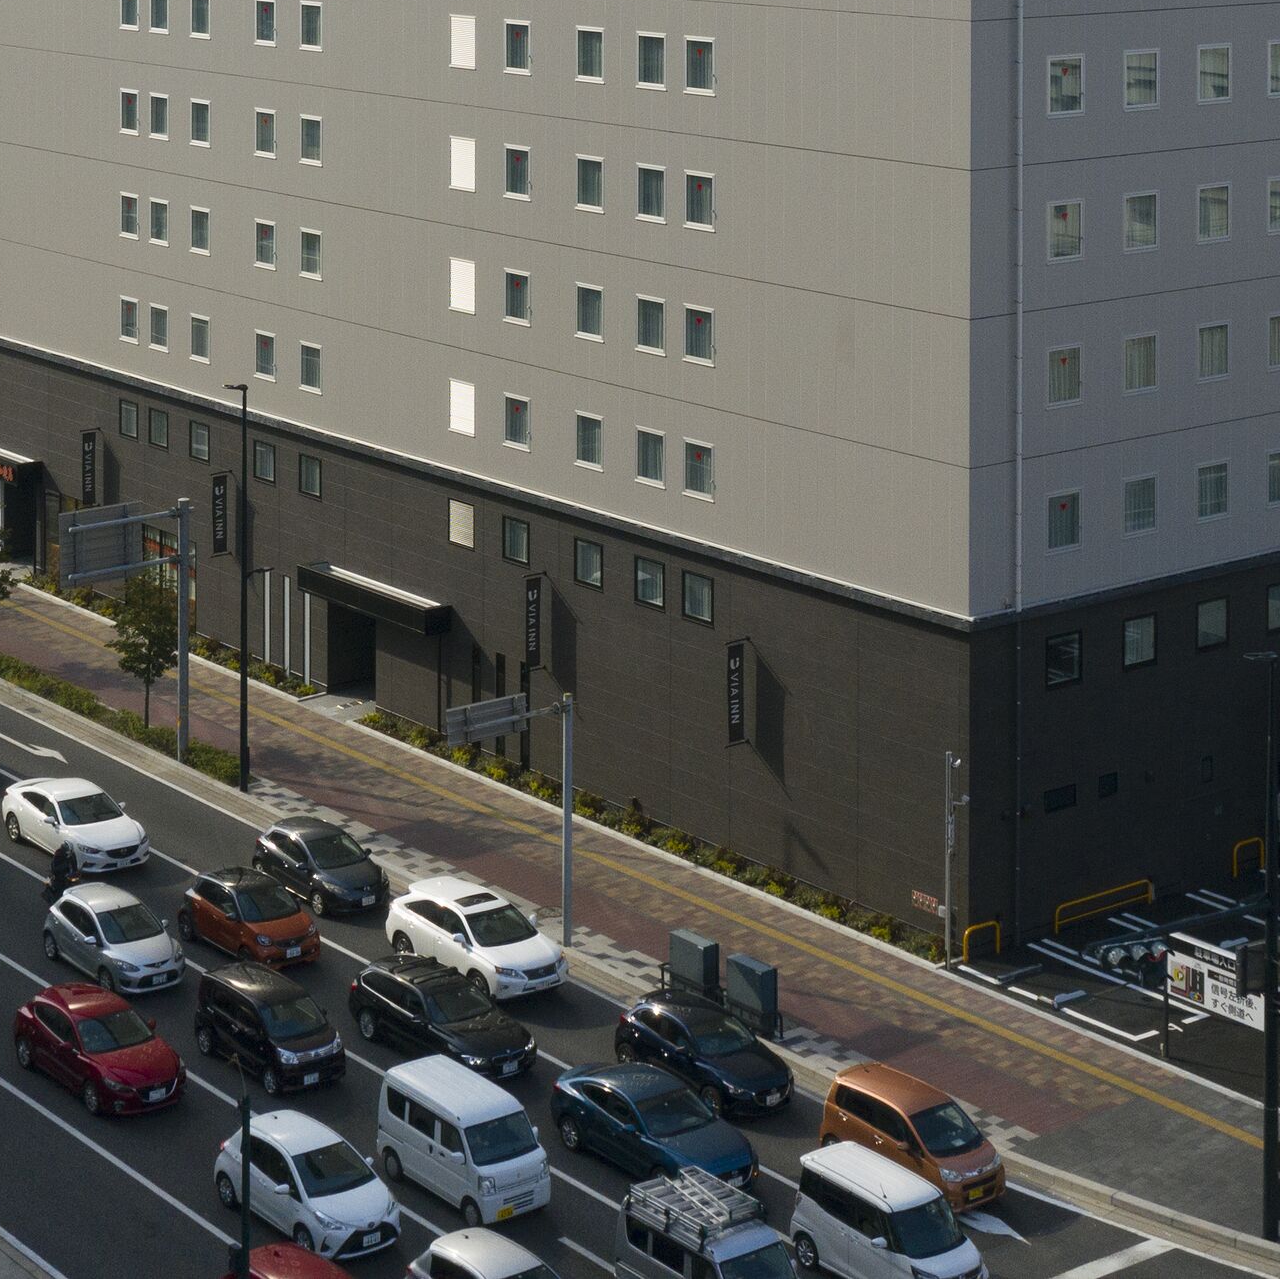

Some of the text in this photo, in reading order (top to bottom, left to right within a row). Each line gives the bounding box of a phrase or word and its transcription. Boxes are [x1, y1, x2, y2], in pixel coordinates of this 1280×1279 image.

[84, 453, 92, 492] VIA INN
[215, 498, 224, 539] VIA INN
[528, 603, 536, 651] VIA INN
[730, 672, 740, 724] VIA INN
[1210, 997, 1255, 1022] すぐ側道へ
